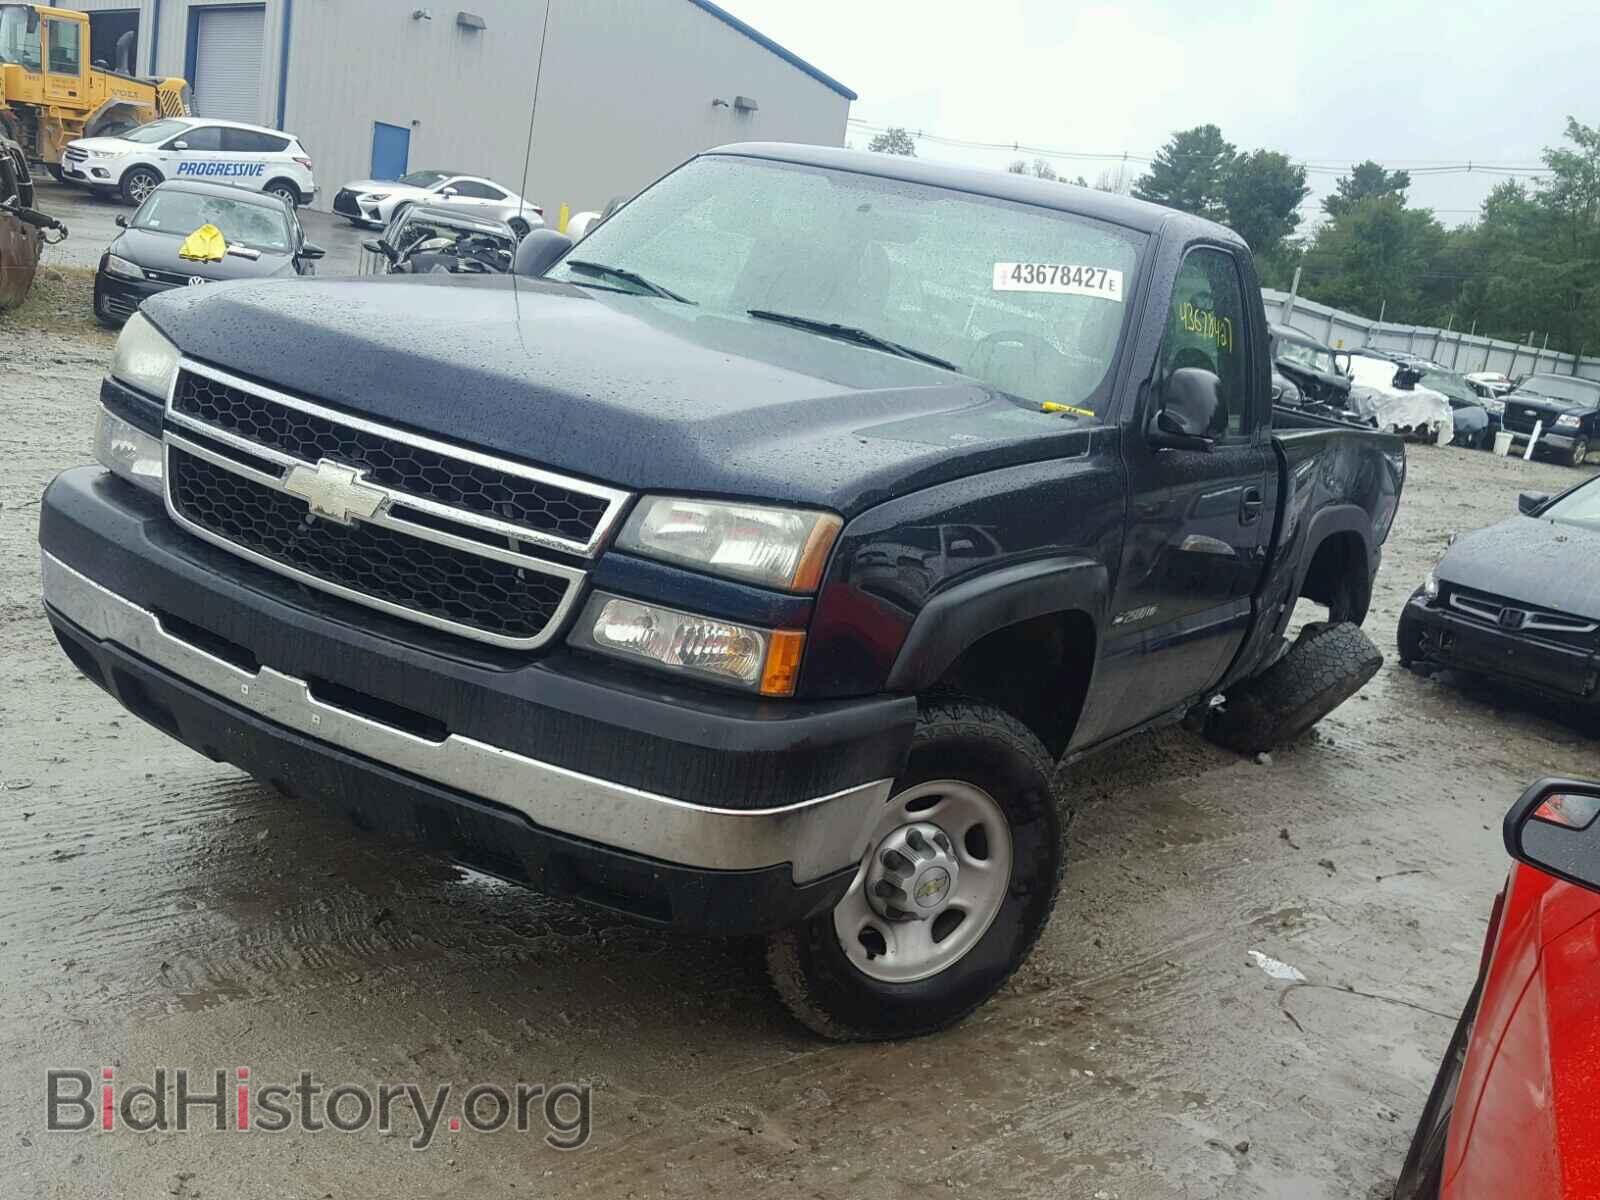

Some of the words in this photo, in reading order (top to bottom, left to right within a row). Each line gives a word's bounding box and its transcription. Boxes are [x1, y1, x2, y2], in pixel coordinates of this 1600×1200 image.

[176, 162, 265, 176] PROGRESSIVE
[1011, 263, 1108, 290] 43678427
[1109, 280, 1116, 292] E
